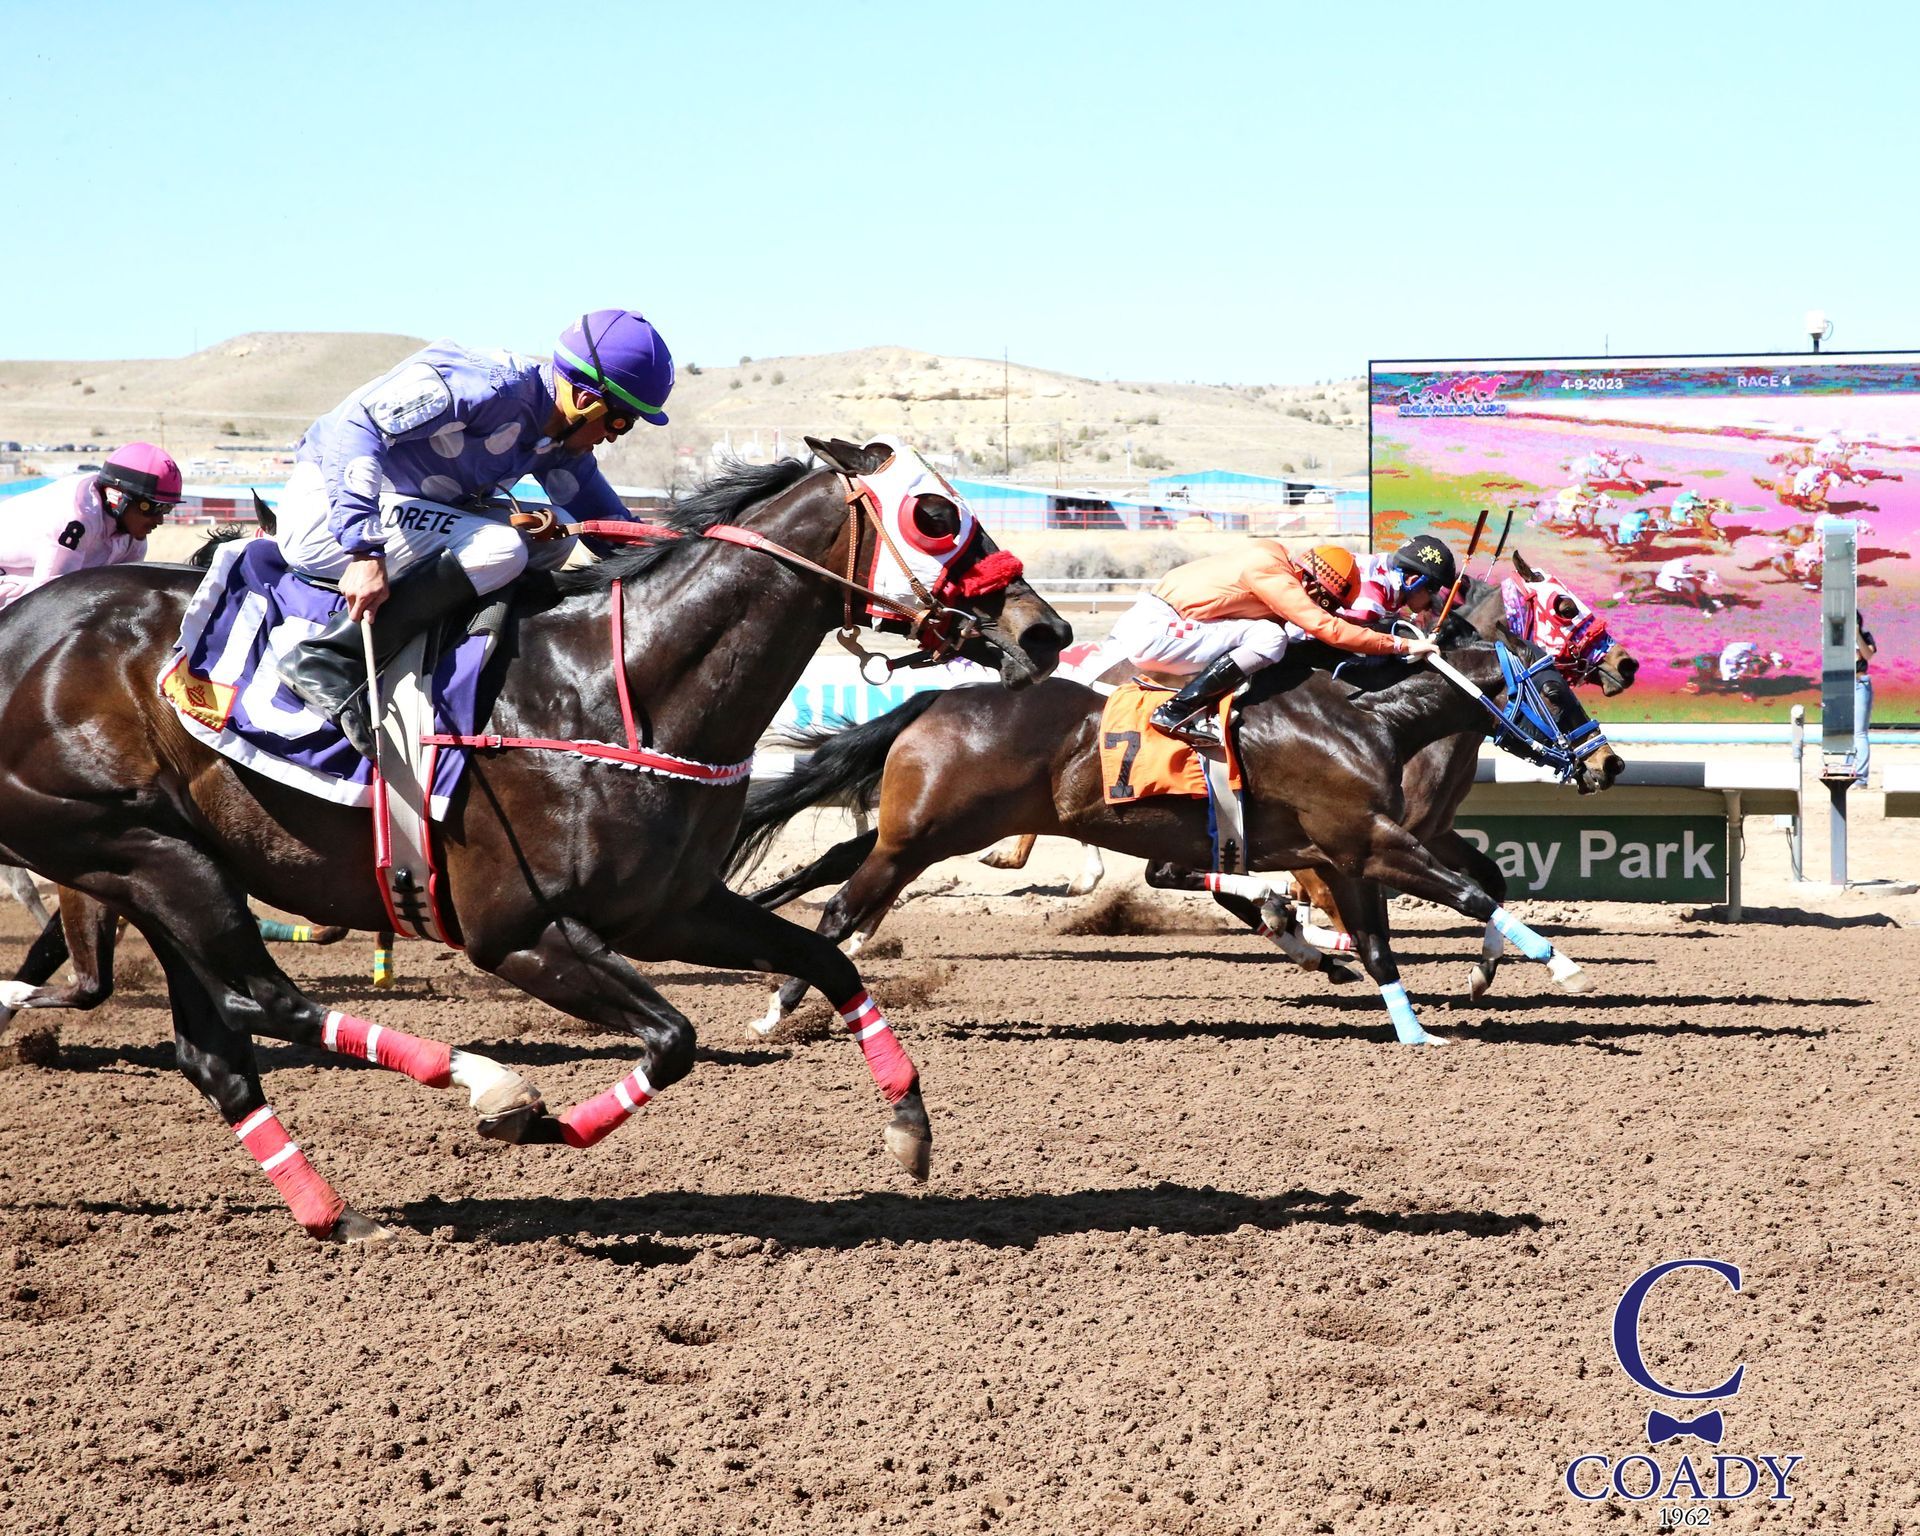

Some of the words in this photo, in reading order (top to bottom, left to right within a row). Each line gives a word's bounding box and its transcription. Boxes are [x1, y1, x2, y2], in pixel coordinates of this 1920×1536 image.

[1561, 378, 1624, 390] 4-9-2023
[1737, 375, 1779, 388] RACE
[1781, 375, 1792, 387] 4
[58, 520, 86, 551] 8
[791, 684, 943, 729] SUN
[1104, 731, 1141, 799] 7
[1579, 830, 1716, 879] Park
